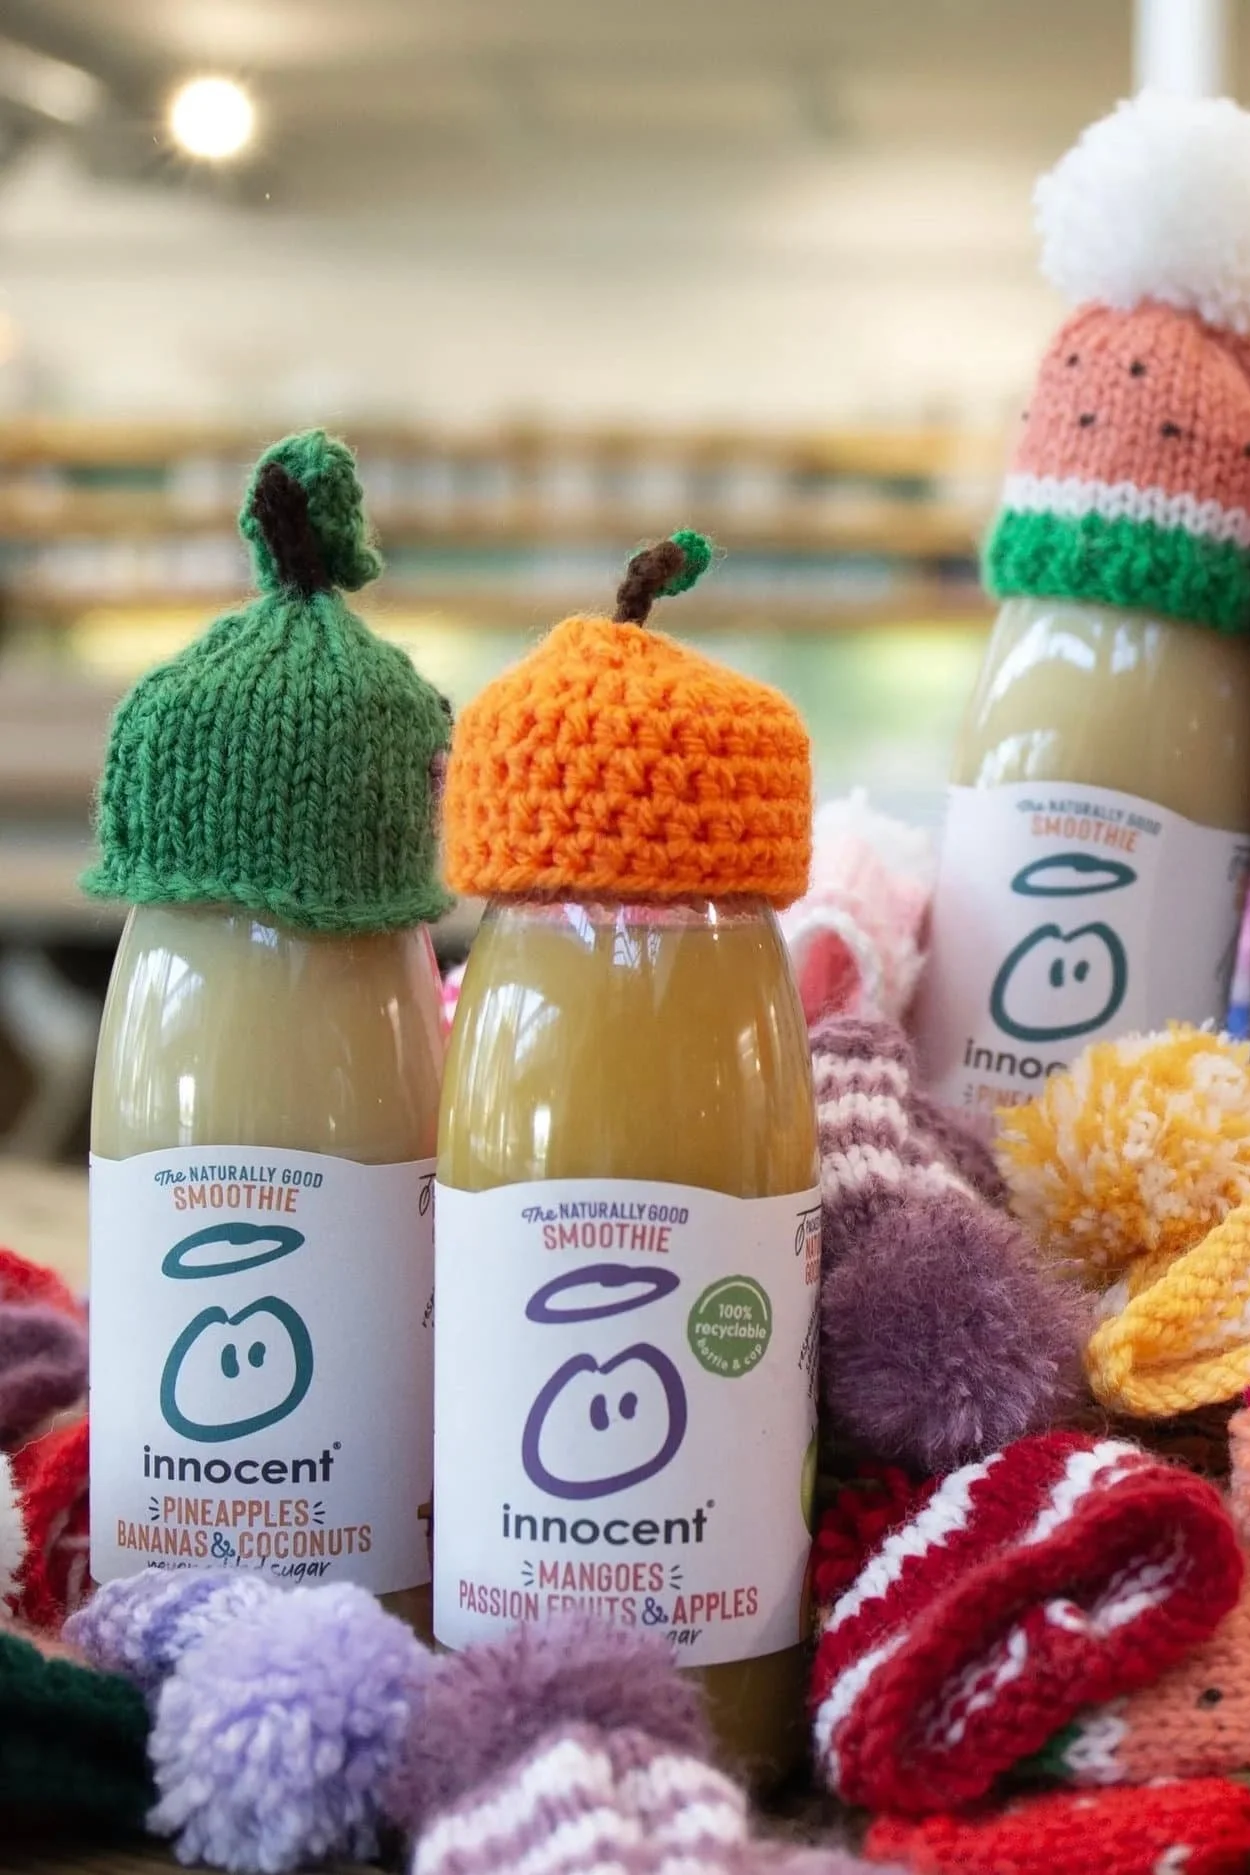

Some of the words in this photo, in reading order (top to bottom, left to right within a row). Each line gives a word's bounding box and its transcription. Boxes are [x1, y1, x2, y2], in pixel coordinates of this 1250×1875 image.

[1031, 814, 1139, 852] SMOOTHIE
[155, 1169, 186, 1186] The
[190, 1165, 278, 1183] NATURALLY
[282, 1169, 323, 1188] GOOD
[173, 1184, 300, 1213] SMOOTHIE
[522, 1206, 557, 1224] The
[560, 1202, 648, 1220] NATURALLY
[648, 1205, 689, 1224] GOOD
[543, 1222, 672, 1253] SMOOTHIE
[719, 1303, 752, 1320] 100%
[695, 1322, 767, 1339] recyclable
[164, 1496, 309, 1528] PINEAPPLES
[118, 1520, 208, 1559] BANANAS
[211, 1532, 236, 1559] &
[239, 1525, 372, 1559] COCONUTS
[538, 1559, 664, 1593] MANGOES
[459, 1579, 539, 1621] PASSION
[641, 1597, 669, 1626] &
[672, 1586, 758, 1625] APPLES
